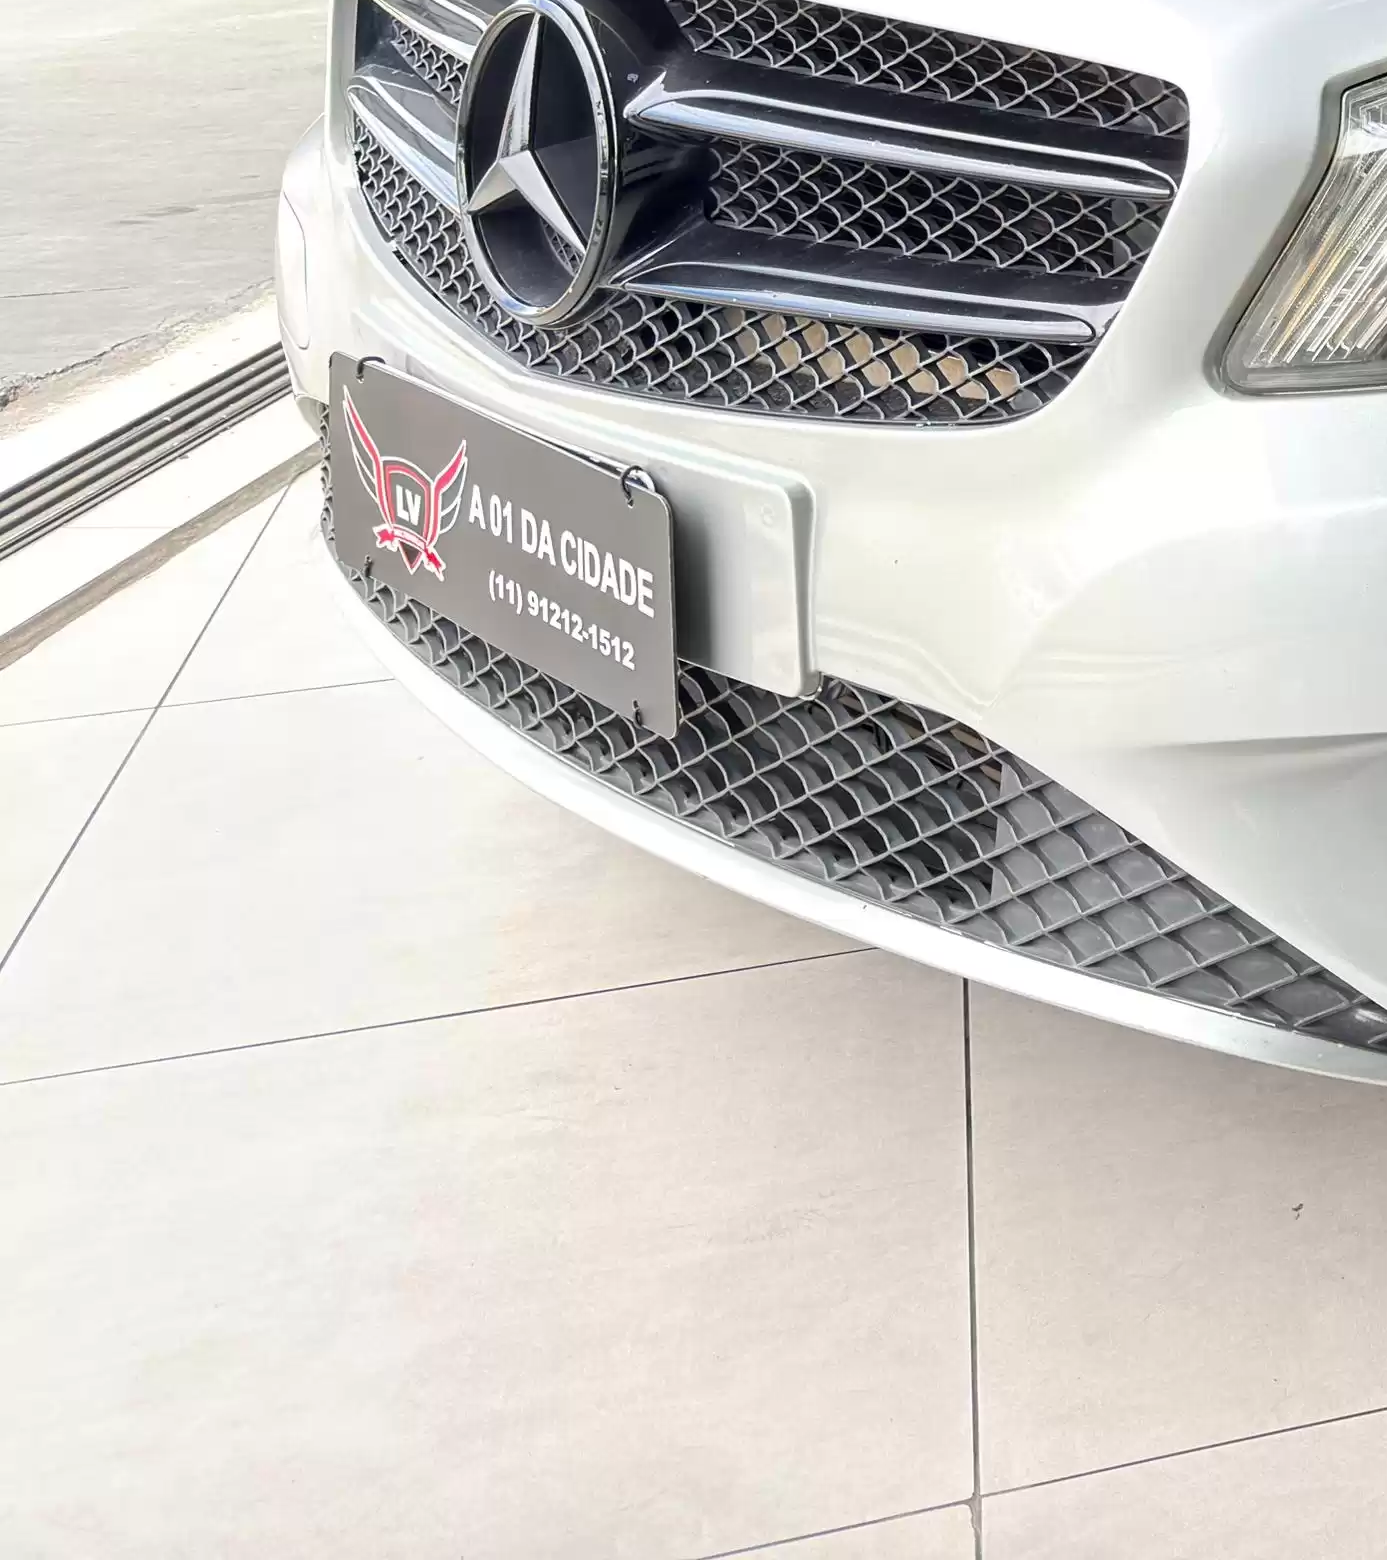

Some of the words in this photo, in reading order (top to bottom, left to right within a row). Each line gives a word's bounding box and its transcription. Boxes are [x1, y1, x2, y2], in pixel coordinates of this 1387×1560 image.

[395, 484, 421, 526] LV
[468, 484, 486, 530] A
[489, 494, 513, 544] 01
[521, 508, 556, 566] DA
[560, 529, 655, 618] CIDADE
[489, 570, 523, 615] (11)
[527, 590, 635, 671] 91212-1512
